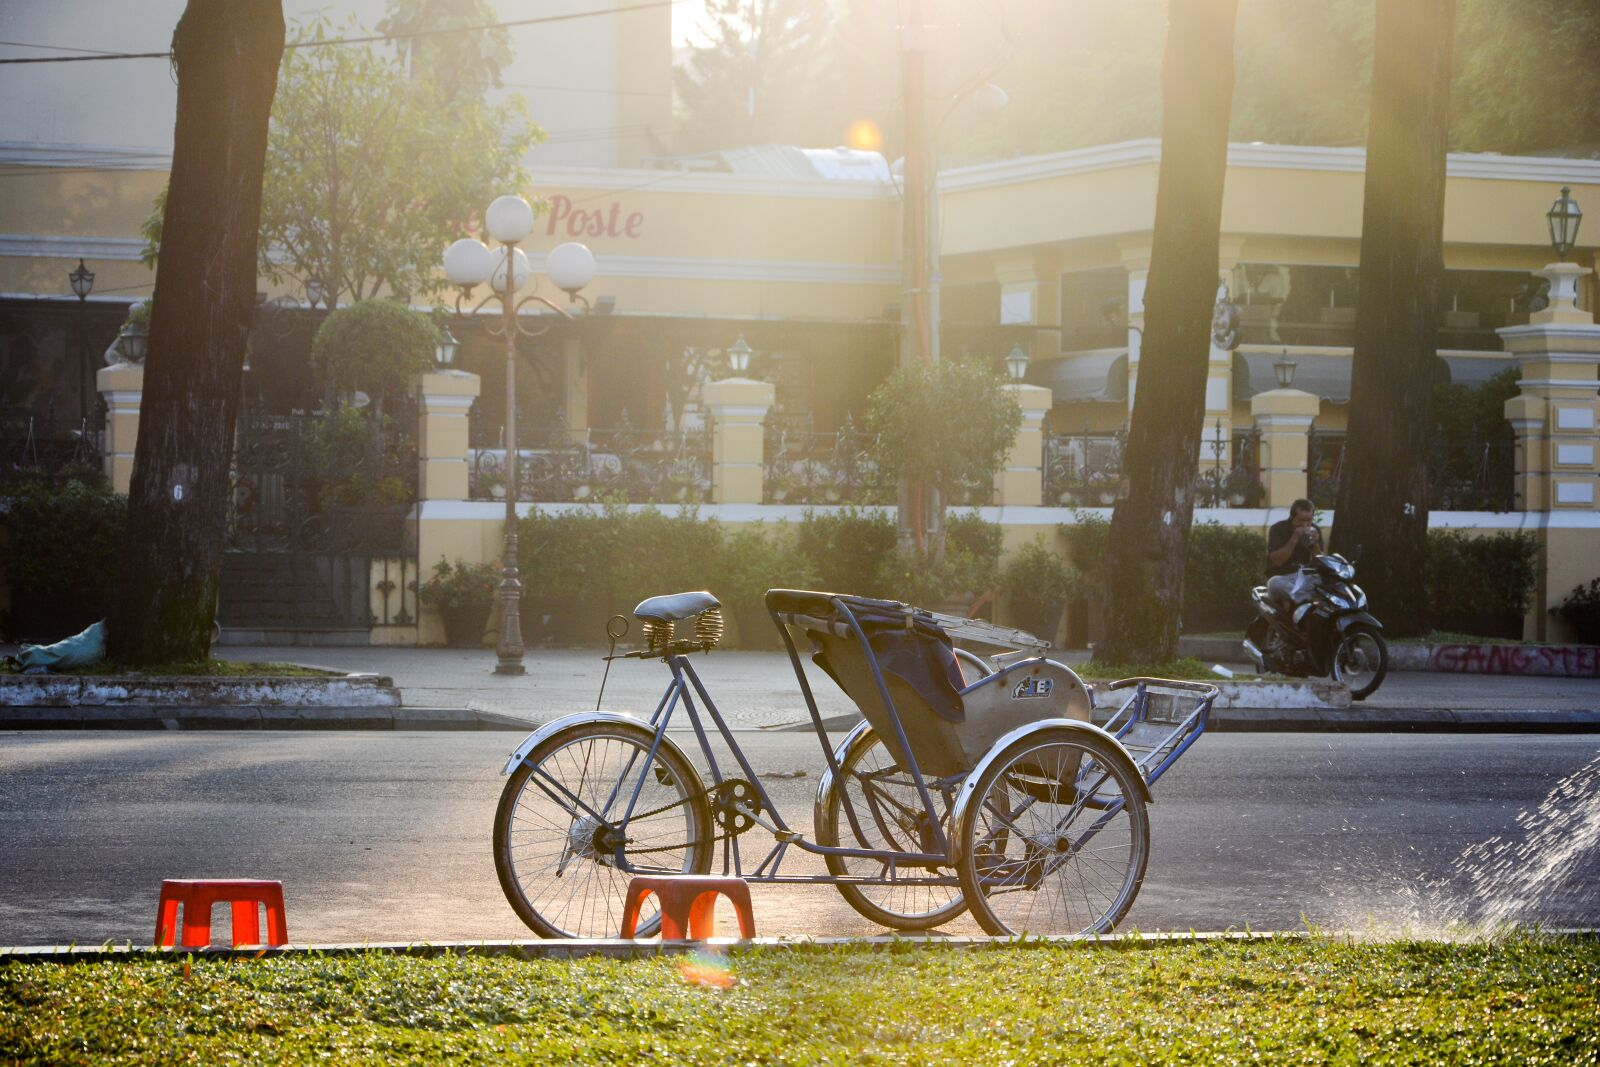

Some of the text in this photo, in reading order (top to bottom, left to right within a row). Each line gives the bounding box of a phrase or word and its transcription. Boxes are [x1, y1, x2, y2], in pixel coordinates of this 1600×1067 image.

[546, 194, 644, 239] Poste
[173, 484, 183, 501] 6
[1163, 510, 1171, 526] 4
